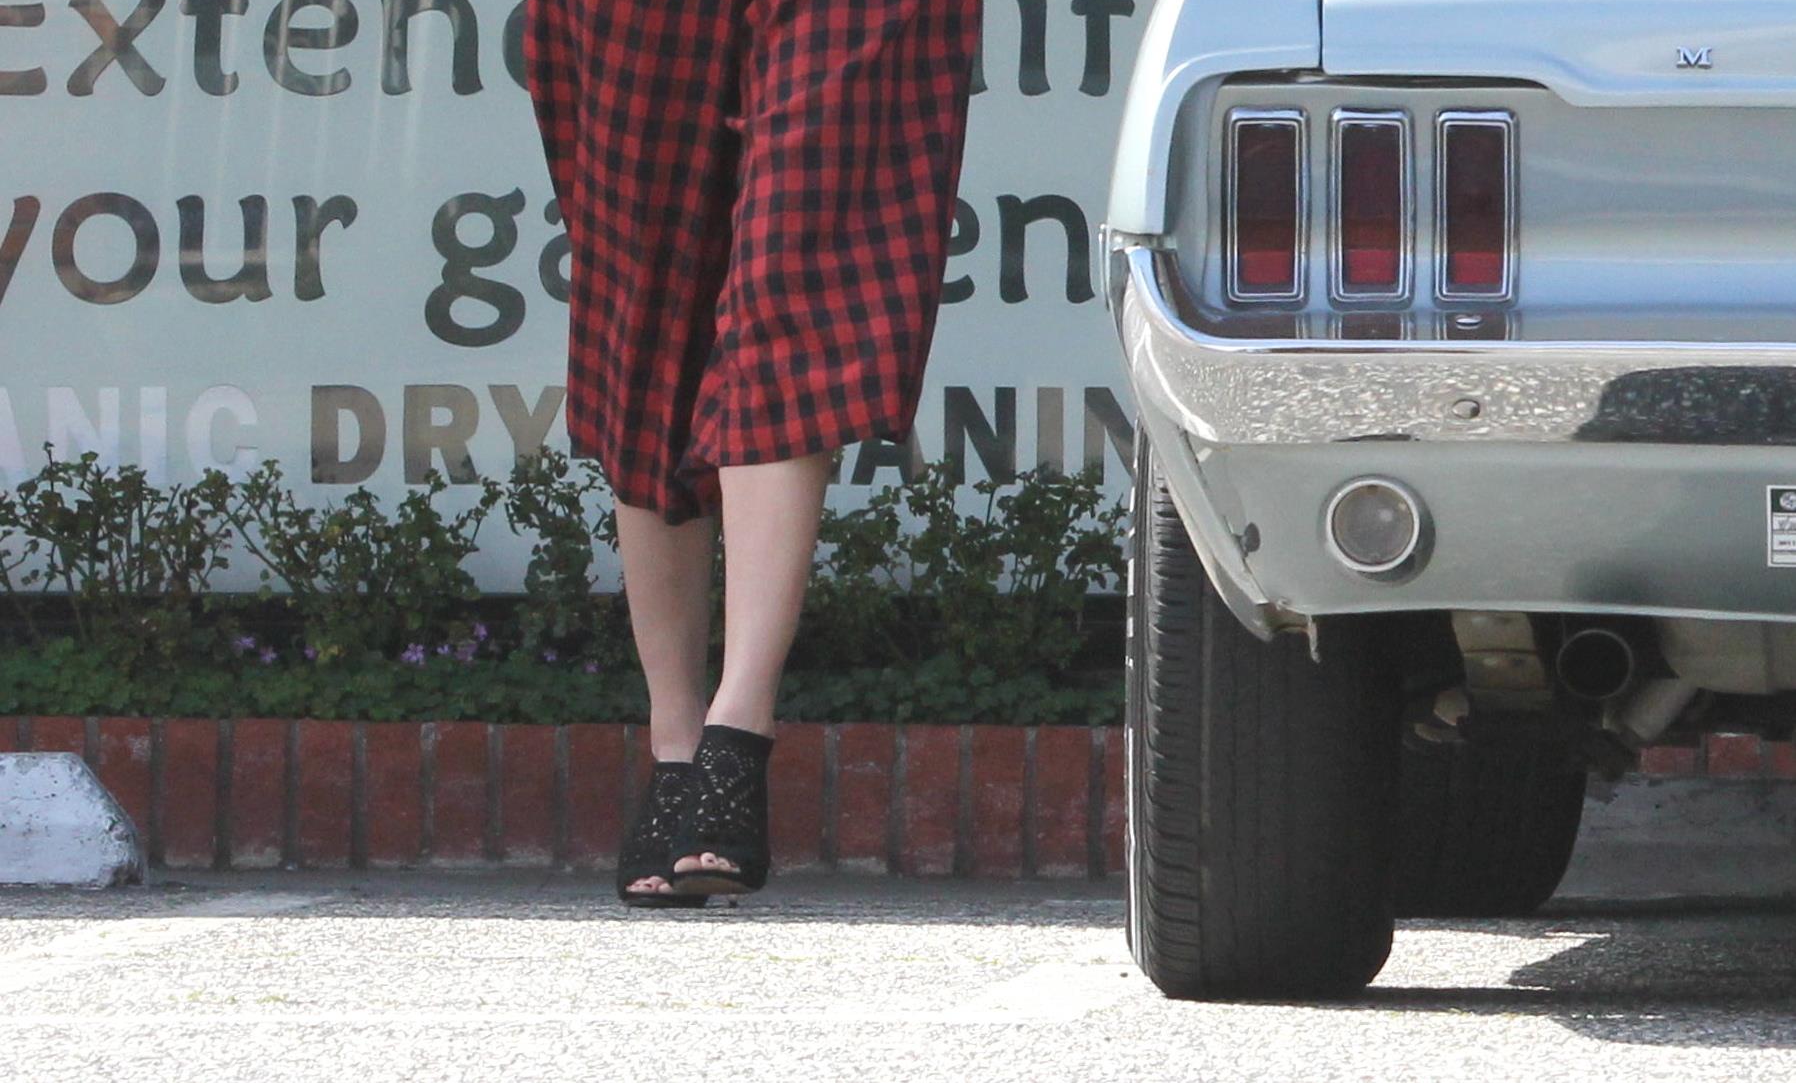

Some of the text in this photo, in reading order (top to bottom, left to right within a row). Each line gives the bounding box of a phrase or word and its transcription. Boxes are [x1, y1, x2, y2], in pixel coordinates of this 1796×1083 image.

[1676, 46, 1712, 68] M
[311, 384, 566, 484] DRY
[826, 386, 1138, 485] ANIN
